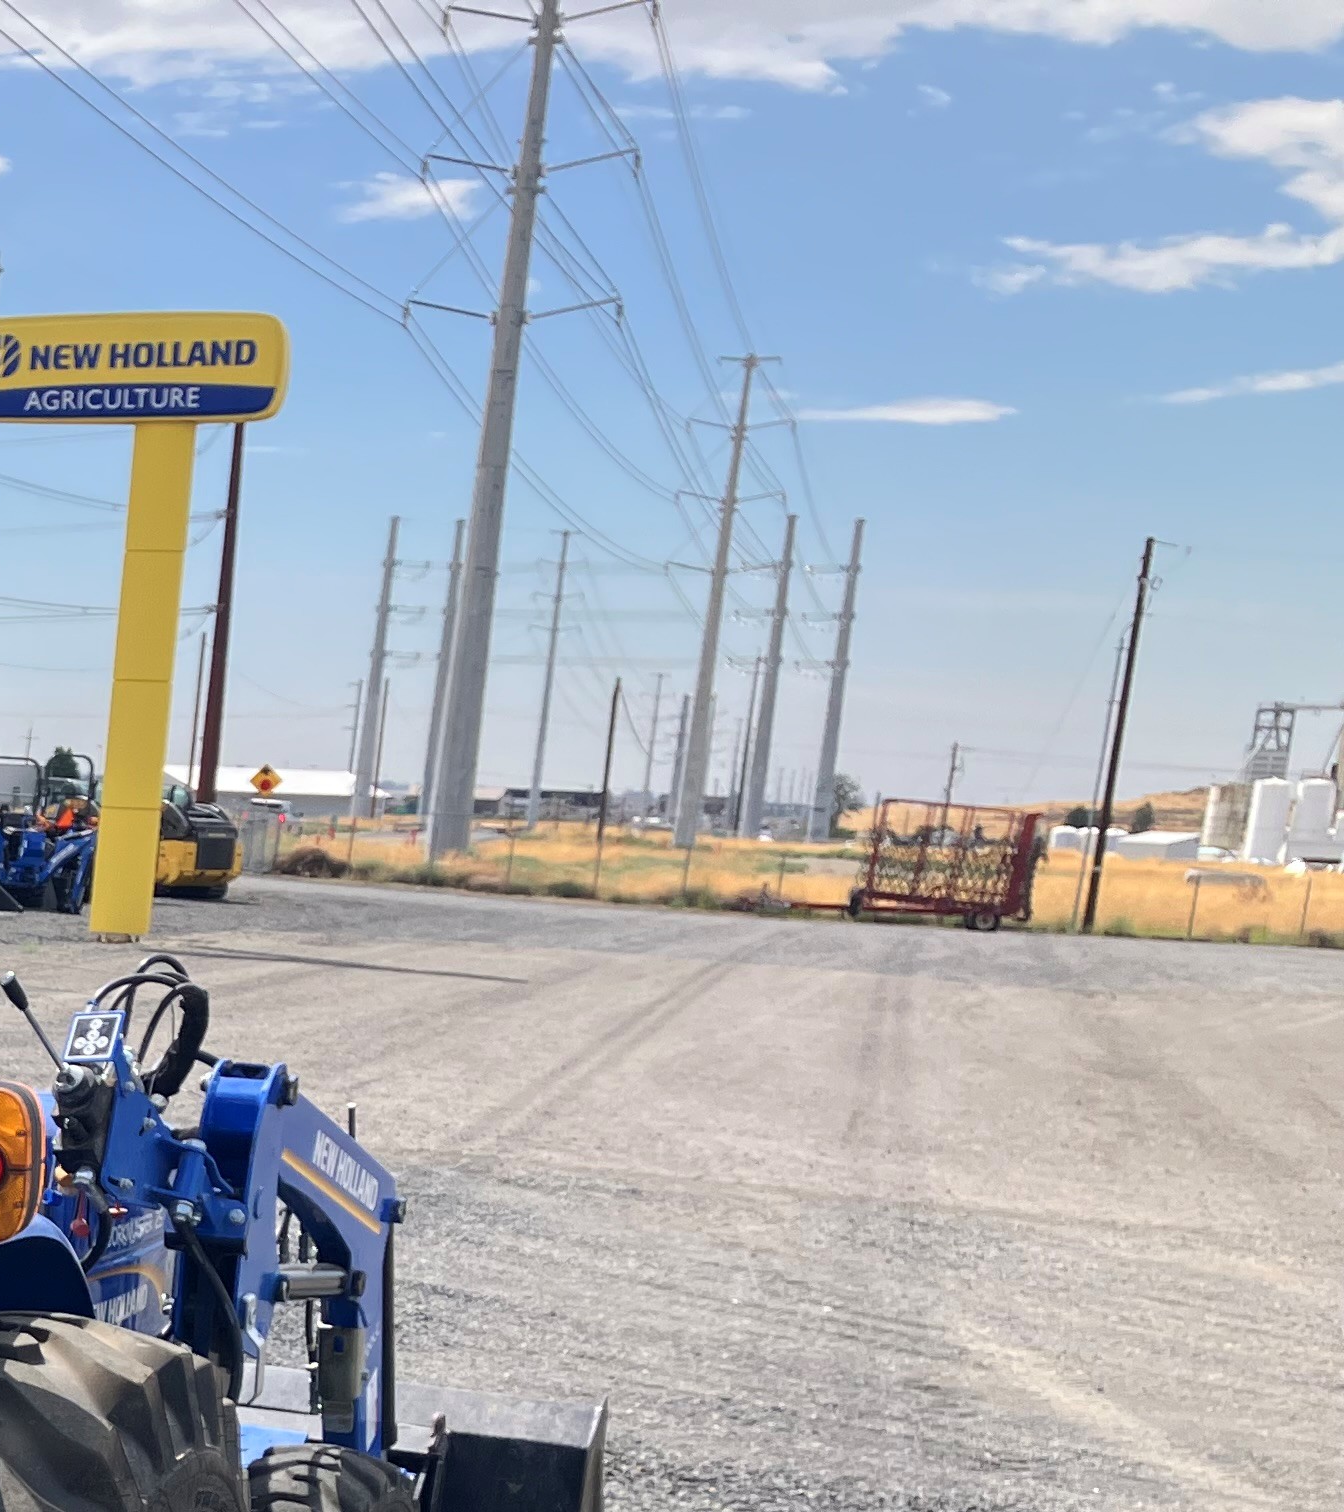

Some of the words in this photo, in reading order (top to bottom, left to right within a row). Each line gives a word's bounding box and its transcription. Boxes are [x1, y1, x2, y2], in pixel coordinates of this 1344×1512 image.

[29, 343, 102, 370] NEW
[109, 339, 257, 368] HOLLAND
[23, 386, 201, 412] AGRICULTURE
[312, 1129, 341, 1178] NEW
[335, 1148, 379, 1212] HOLLAND
